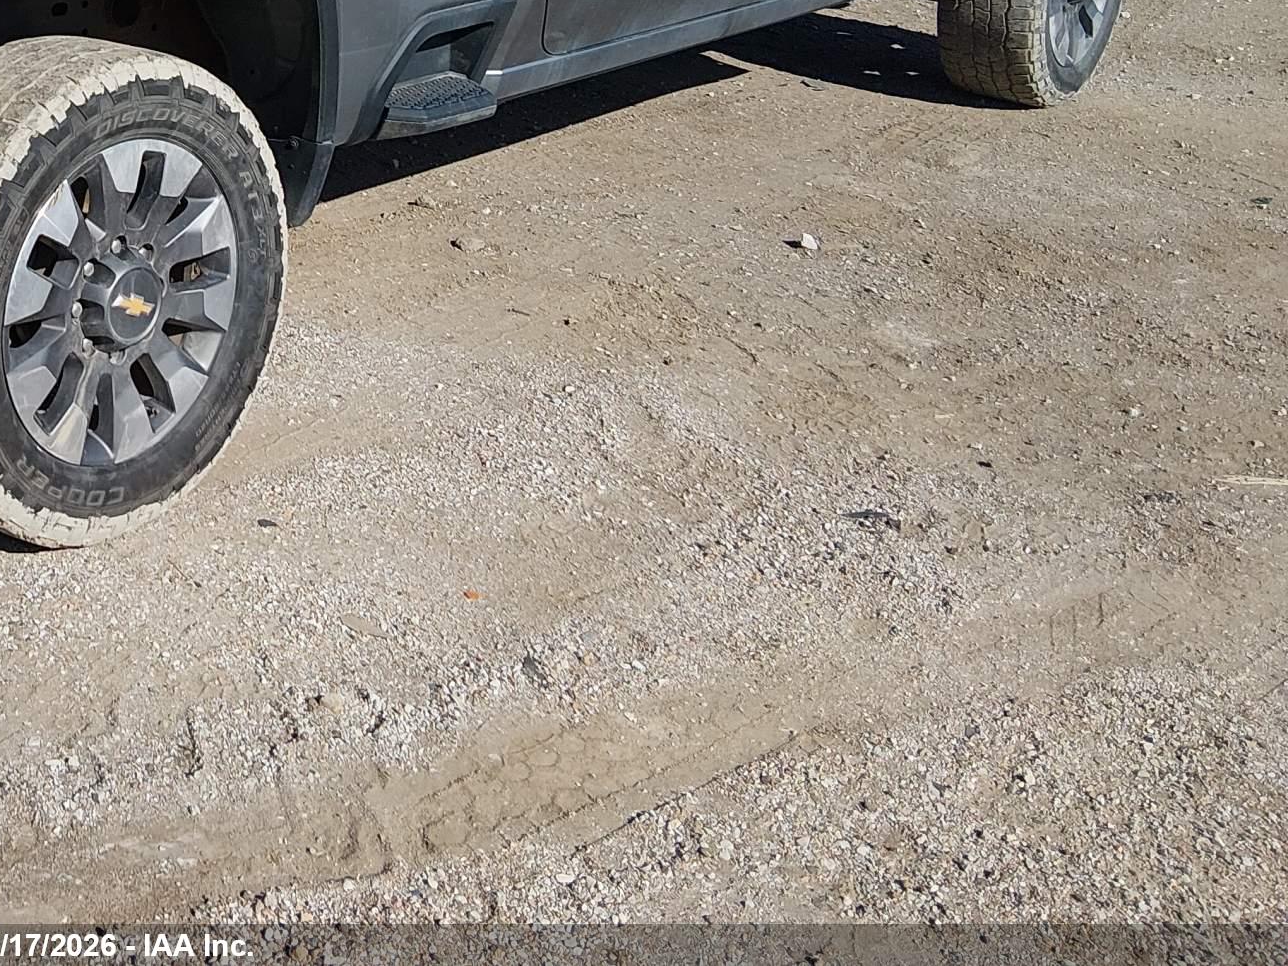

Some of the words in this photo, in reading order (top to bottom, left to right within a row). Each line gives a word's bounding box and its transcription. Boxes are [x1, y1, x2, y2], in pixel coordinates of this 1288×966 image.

[96, 107, 240, 160] DISCOVERER
[239, 171, 264, 221] AT3
[16, 455, 125, 506] COOPER
